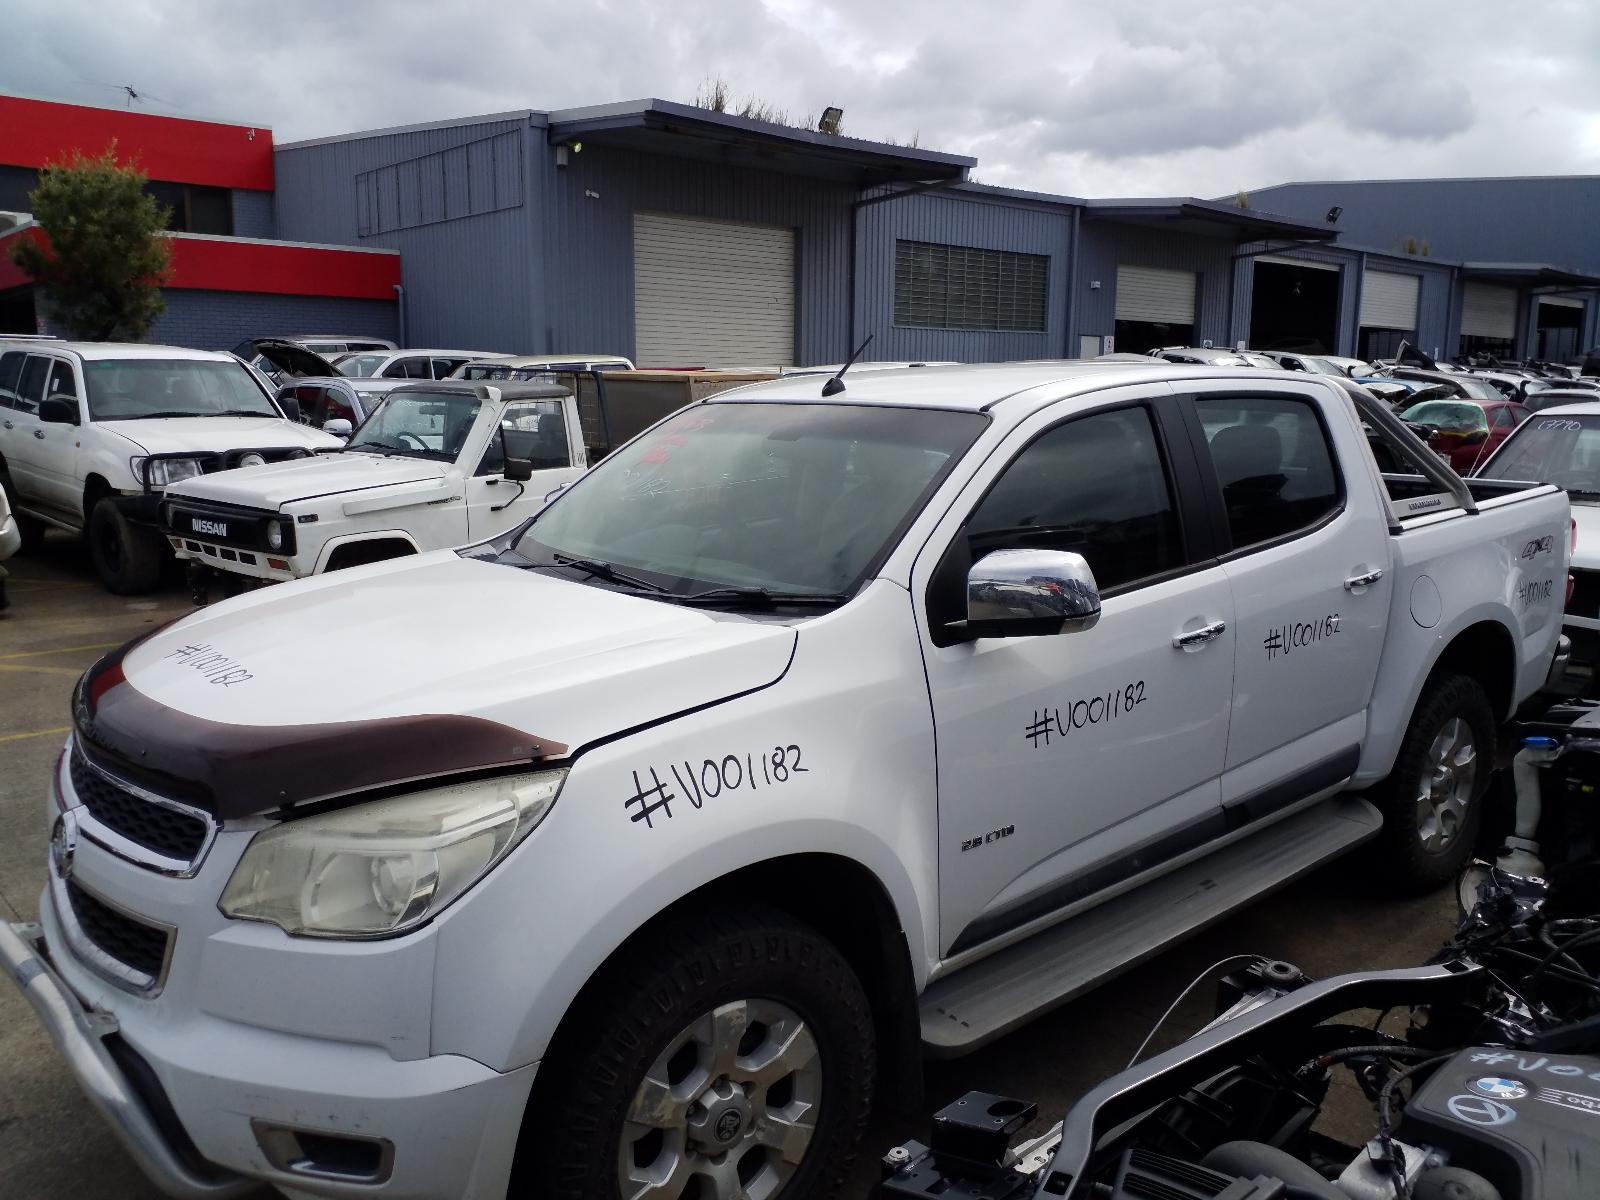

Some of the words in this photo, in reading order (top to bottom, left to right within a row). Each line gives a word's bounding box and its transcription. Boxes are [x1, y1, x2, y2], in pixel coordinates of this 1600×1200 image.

[192, 518, 227, 537] NISSAN
[1263, 613, 1342, 661] #V001182
[1025, 680, 1148, 749] #V001182
[624, 744, 811, 829] #V001182
